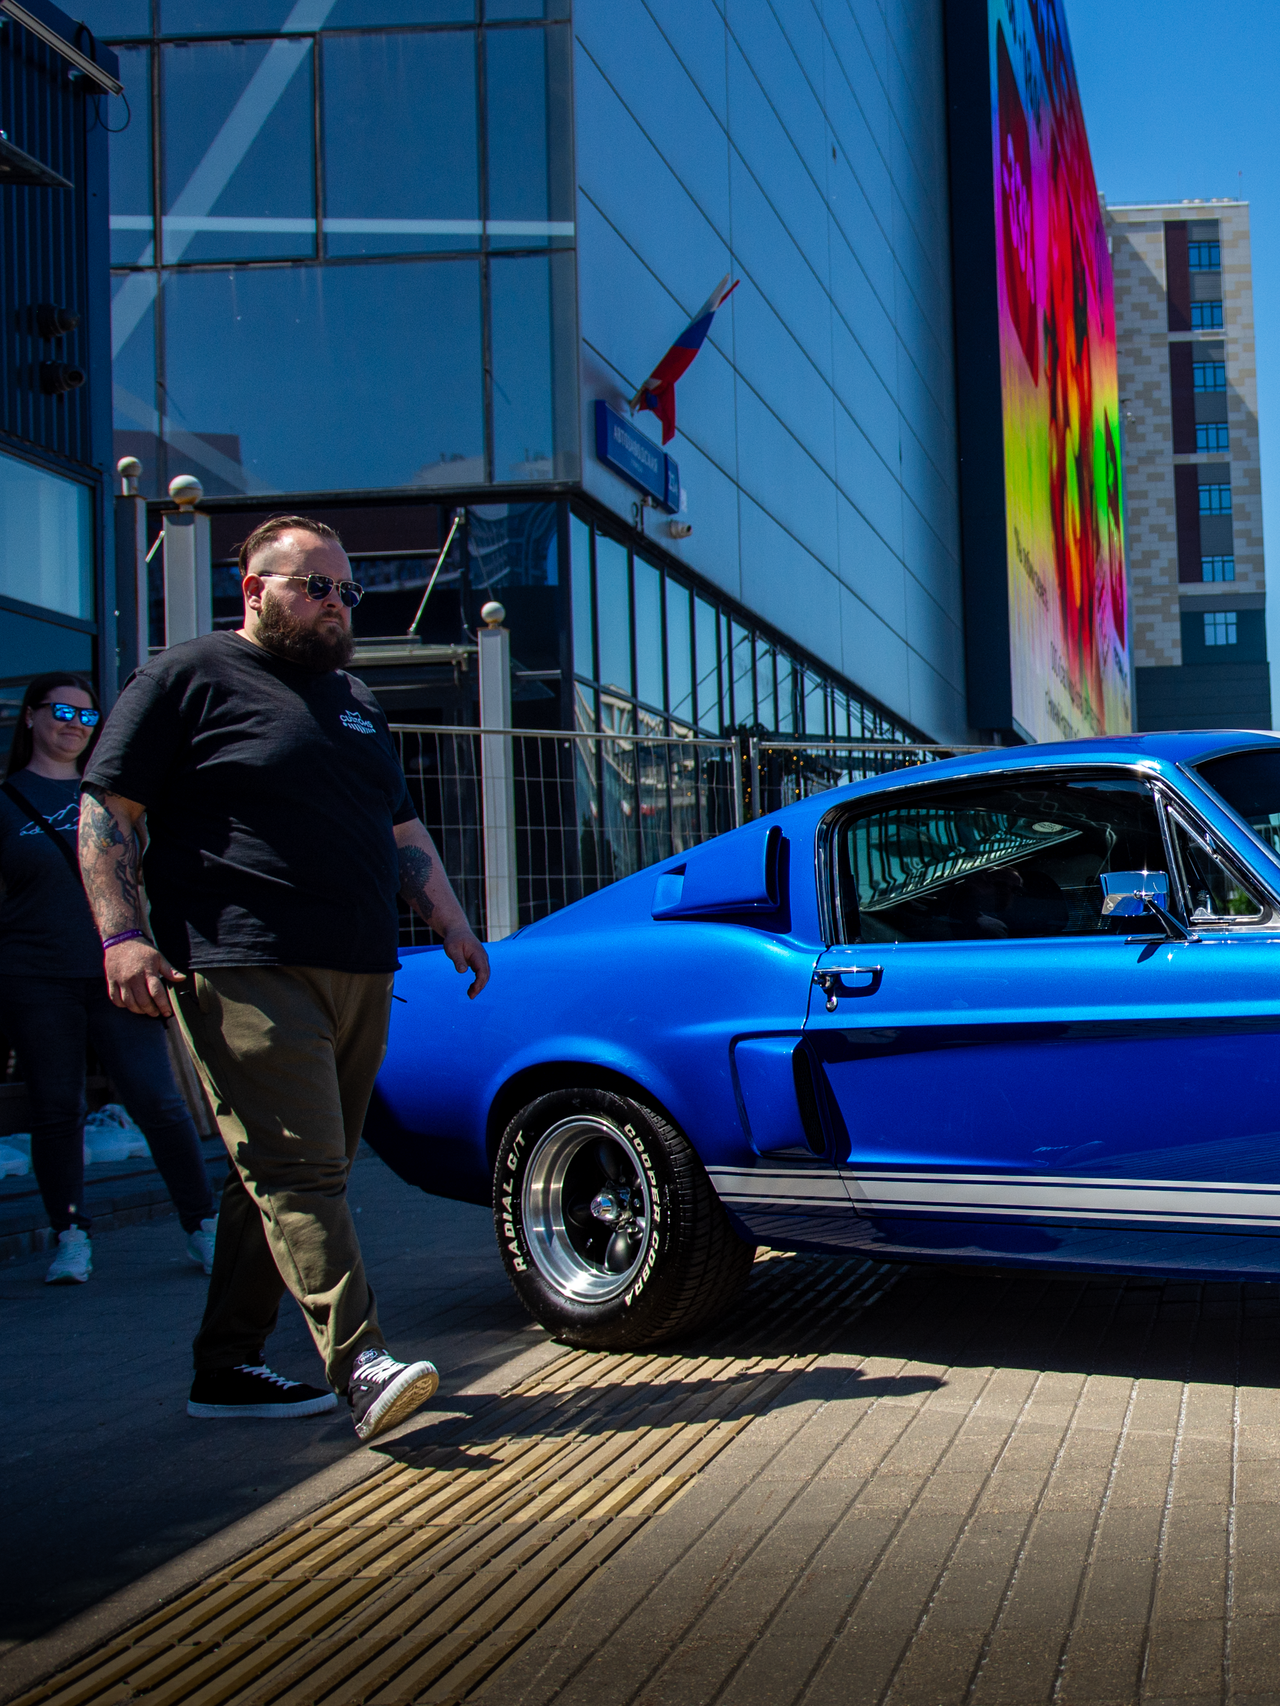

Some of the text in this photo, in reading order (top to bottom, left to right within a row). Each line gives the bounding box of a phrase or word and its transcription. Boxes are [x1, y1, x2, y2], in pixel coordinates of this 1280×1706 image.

[502, 1129, 528, 1272] RADIAL G/T
[624, 1123, 661, 1307] COOPER COBRA
